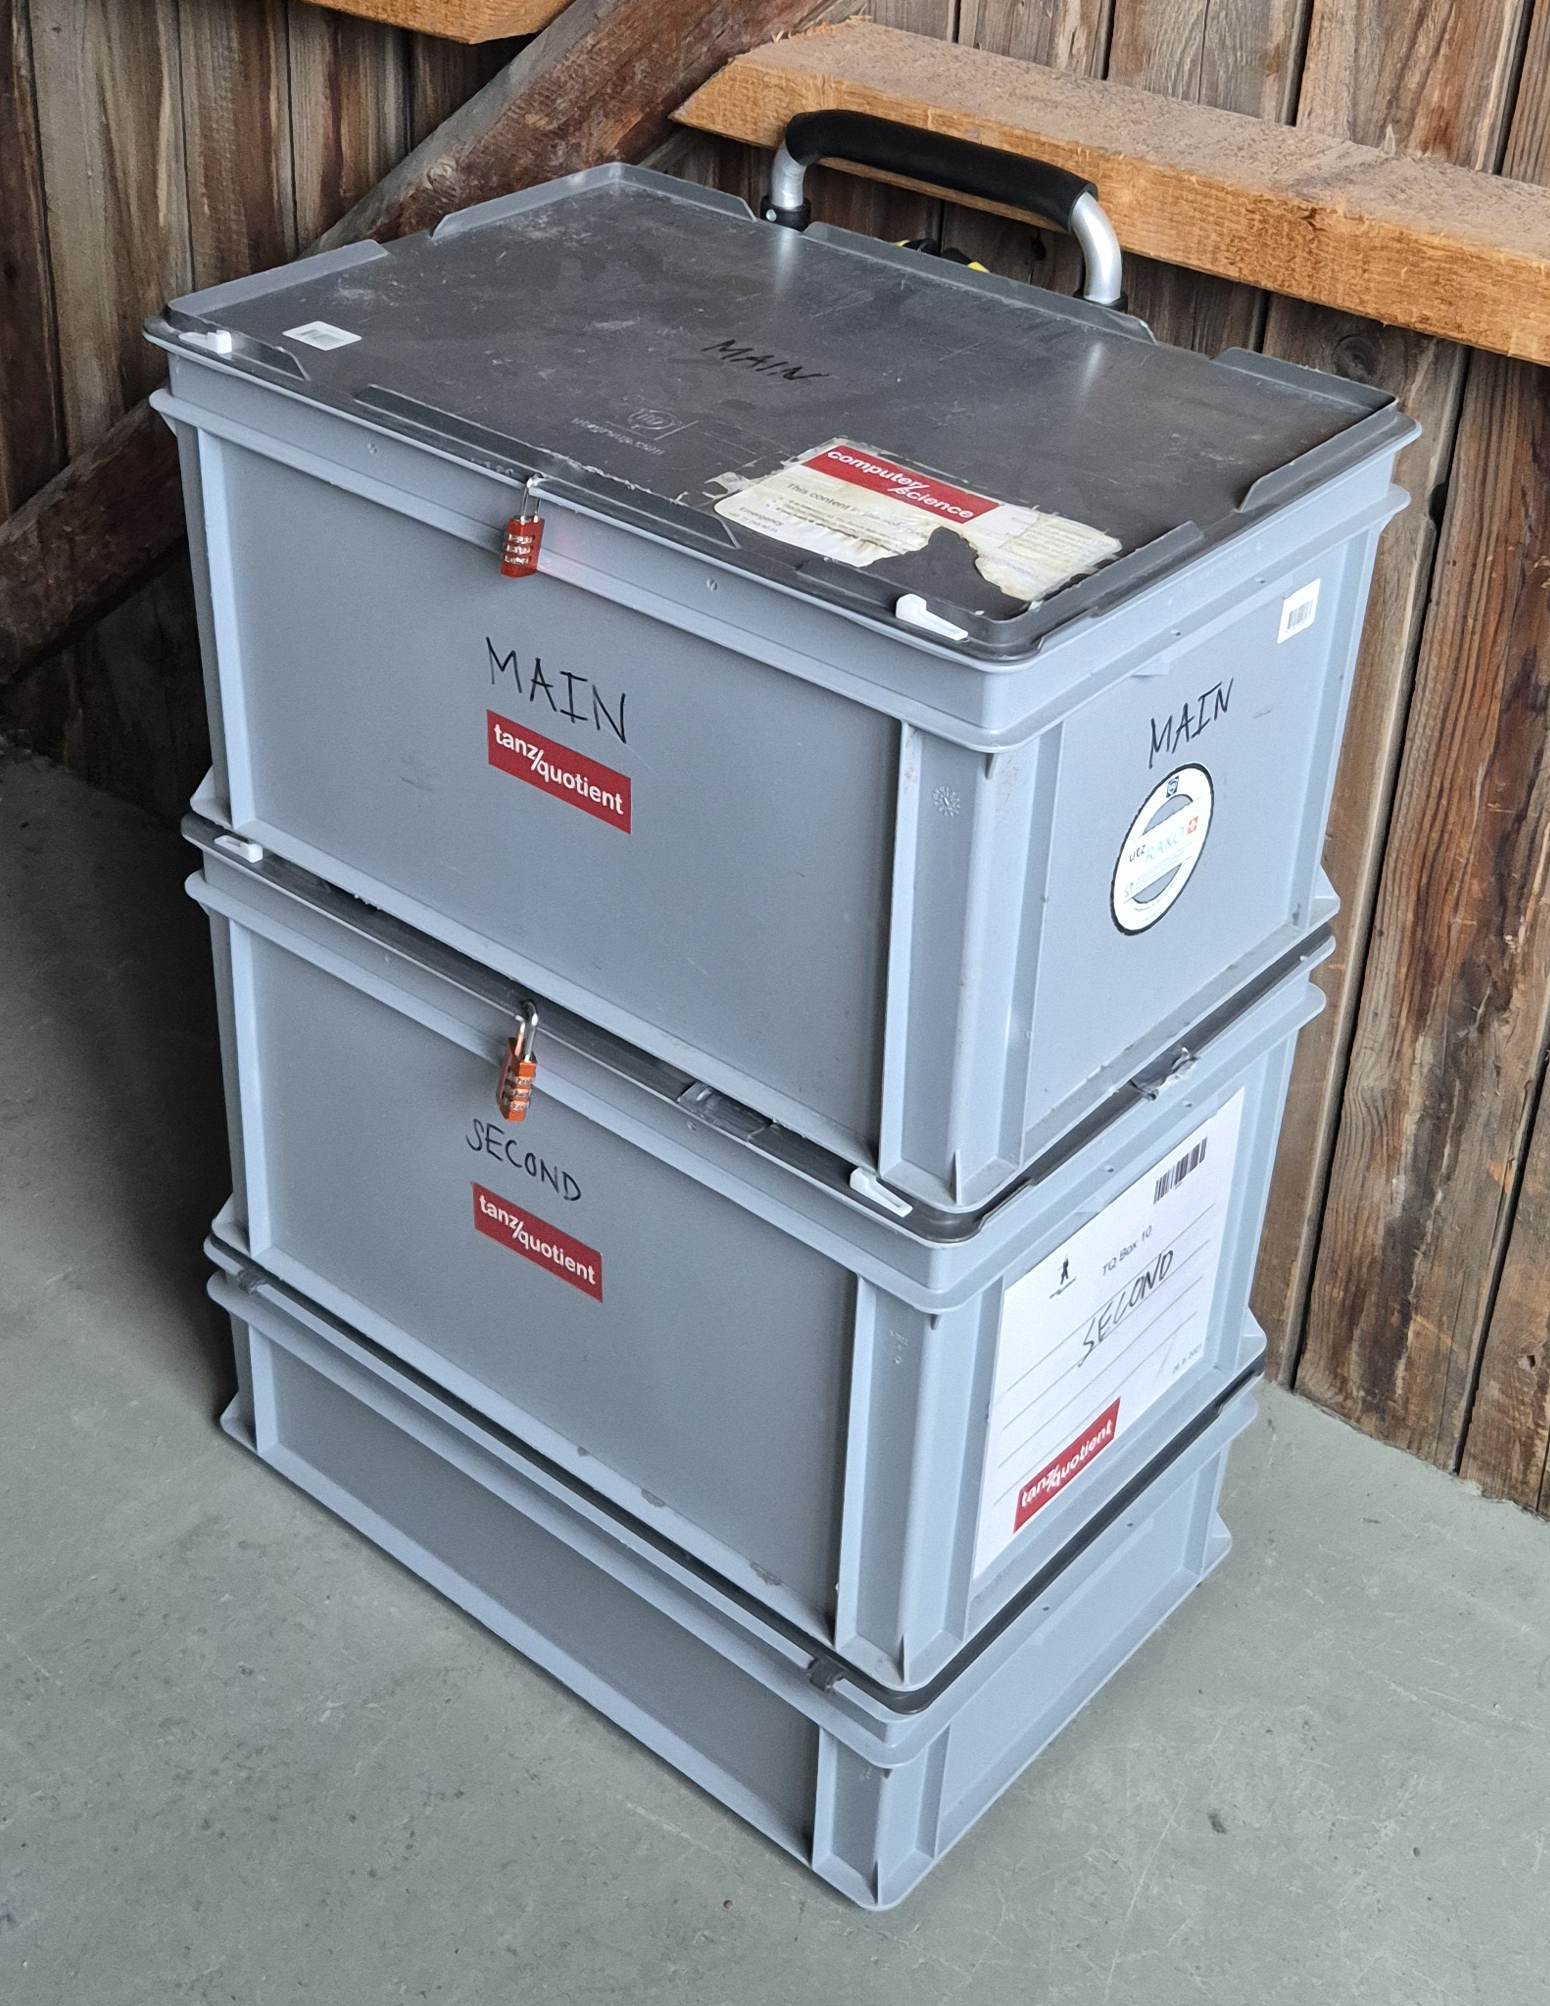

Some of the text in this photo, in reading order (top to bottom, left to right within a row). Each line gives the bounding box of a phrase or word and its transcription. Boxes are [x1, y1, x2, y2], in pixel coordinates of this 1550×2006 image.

[701, 339, 830, 381] MAIN
[787, 483, 851, 511] This content
[485, 636, 629, 745] MAIN
[1148, 677, 1236, 770] MAIN
[493, 722, 625, 816] tanz/quotient
[466, 1118, 581, 1202] SECOND
[479, 1193, 597, 1285] tanz/quotient
[1102, 1257, 1119, 1277] TQ
[1118, 1241, 1139, 1264] Box
[1077, 1248, 1175, 1369] SECOND
[1020, 1419, 1114, 1509] tanz/quotient
